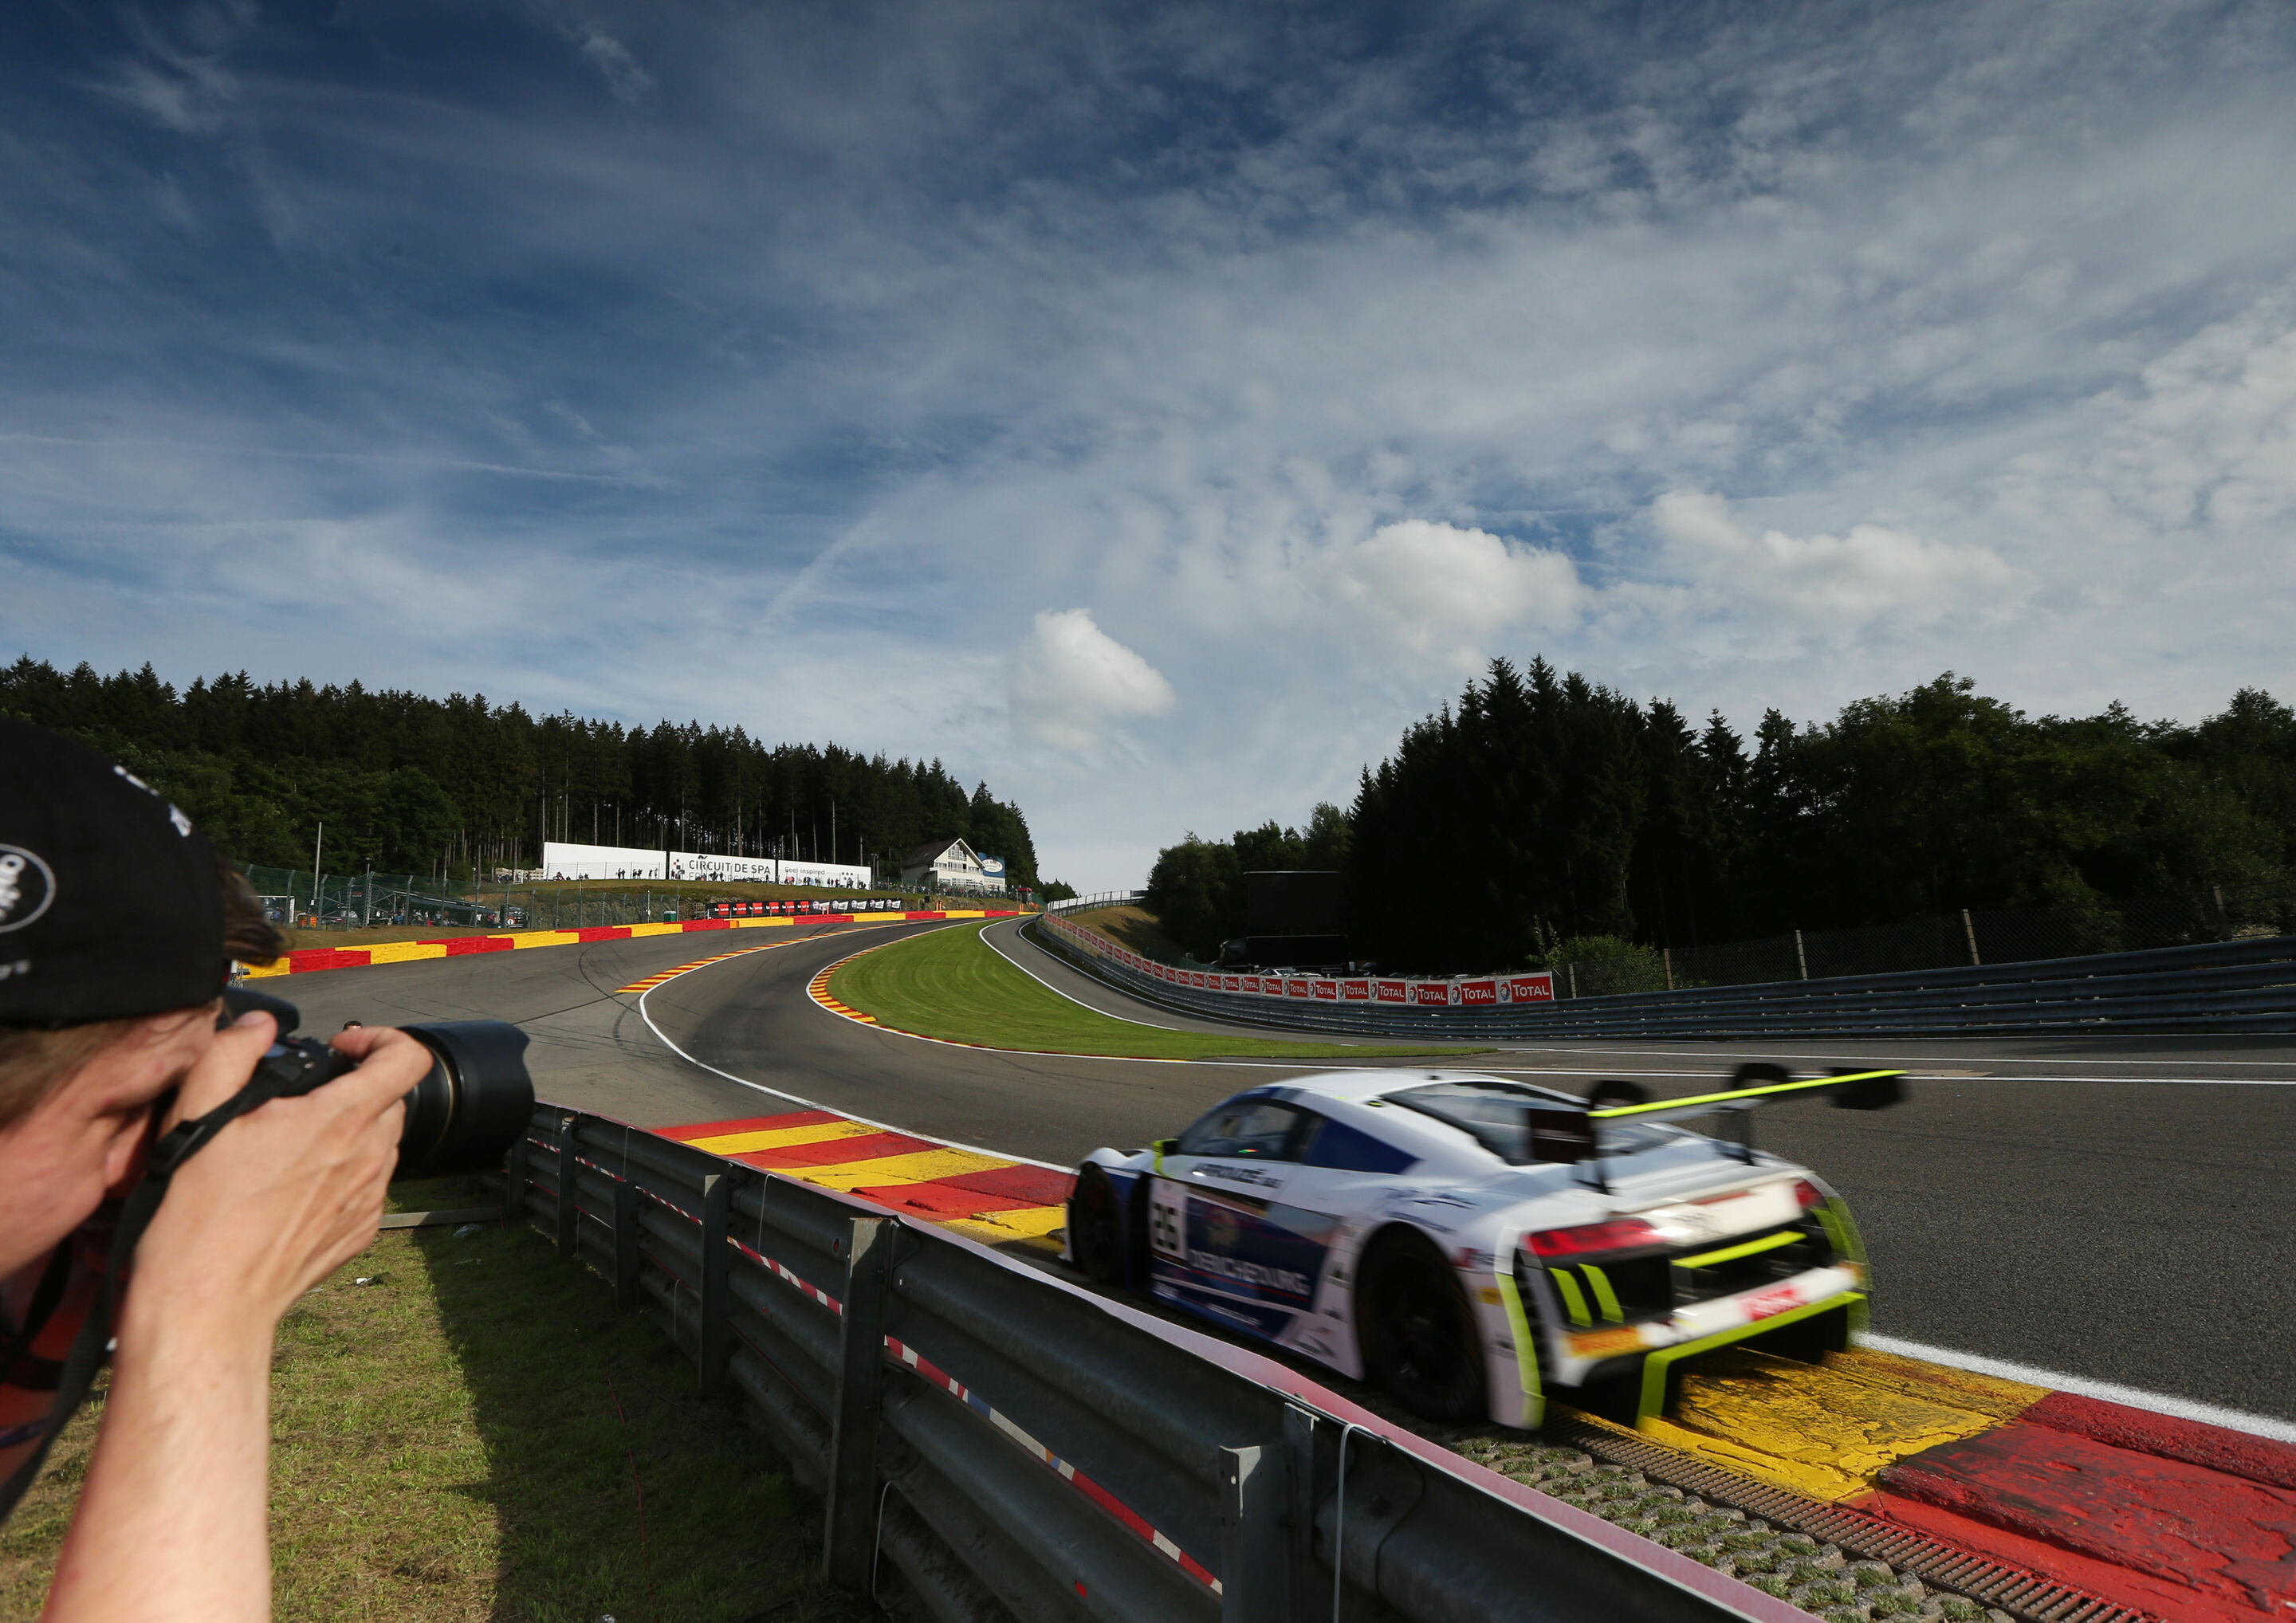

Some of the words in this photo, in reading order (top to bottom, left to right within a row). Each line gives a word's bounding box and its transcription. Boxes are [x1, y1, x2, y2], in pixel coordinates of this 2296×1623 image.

[689, 860, 731, 872] CIRCUIT
[734, 863, 748, 873] DE
[751, 865, 771, 874] SPA
[1244, 980, 1259, 989] TOTAL
[1266, 981, 1282, 991] TOTAL
[1290, 984, 1307, 994] TOTAL
[1316, 984, 1335, 995] TOTAL
[1345, 984, 1368, 995] TOTAL
[1512, 984, 1550, 996] TOTAL
[1380, 985, 1405, 997] TOTAL
[1418, 988, 1447, 1000] TOTAL
[1462, 988, 1495, 1000] TOTAL
